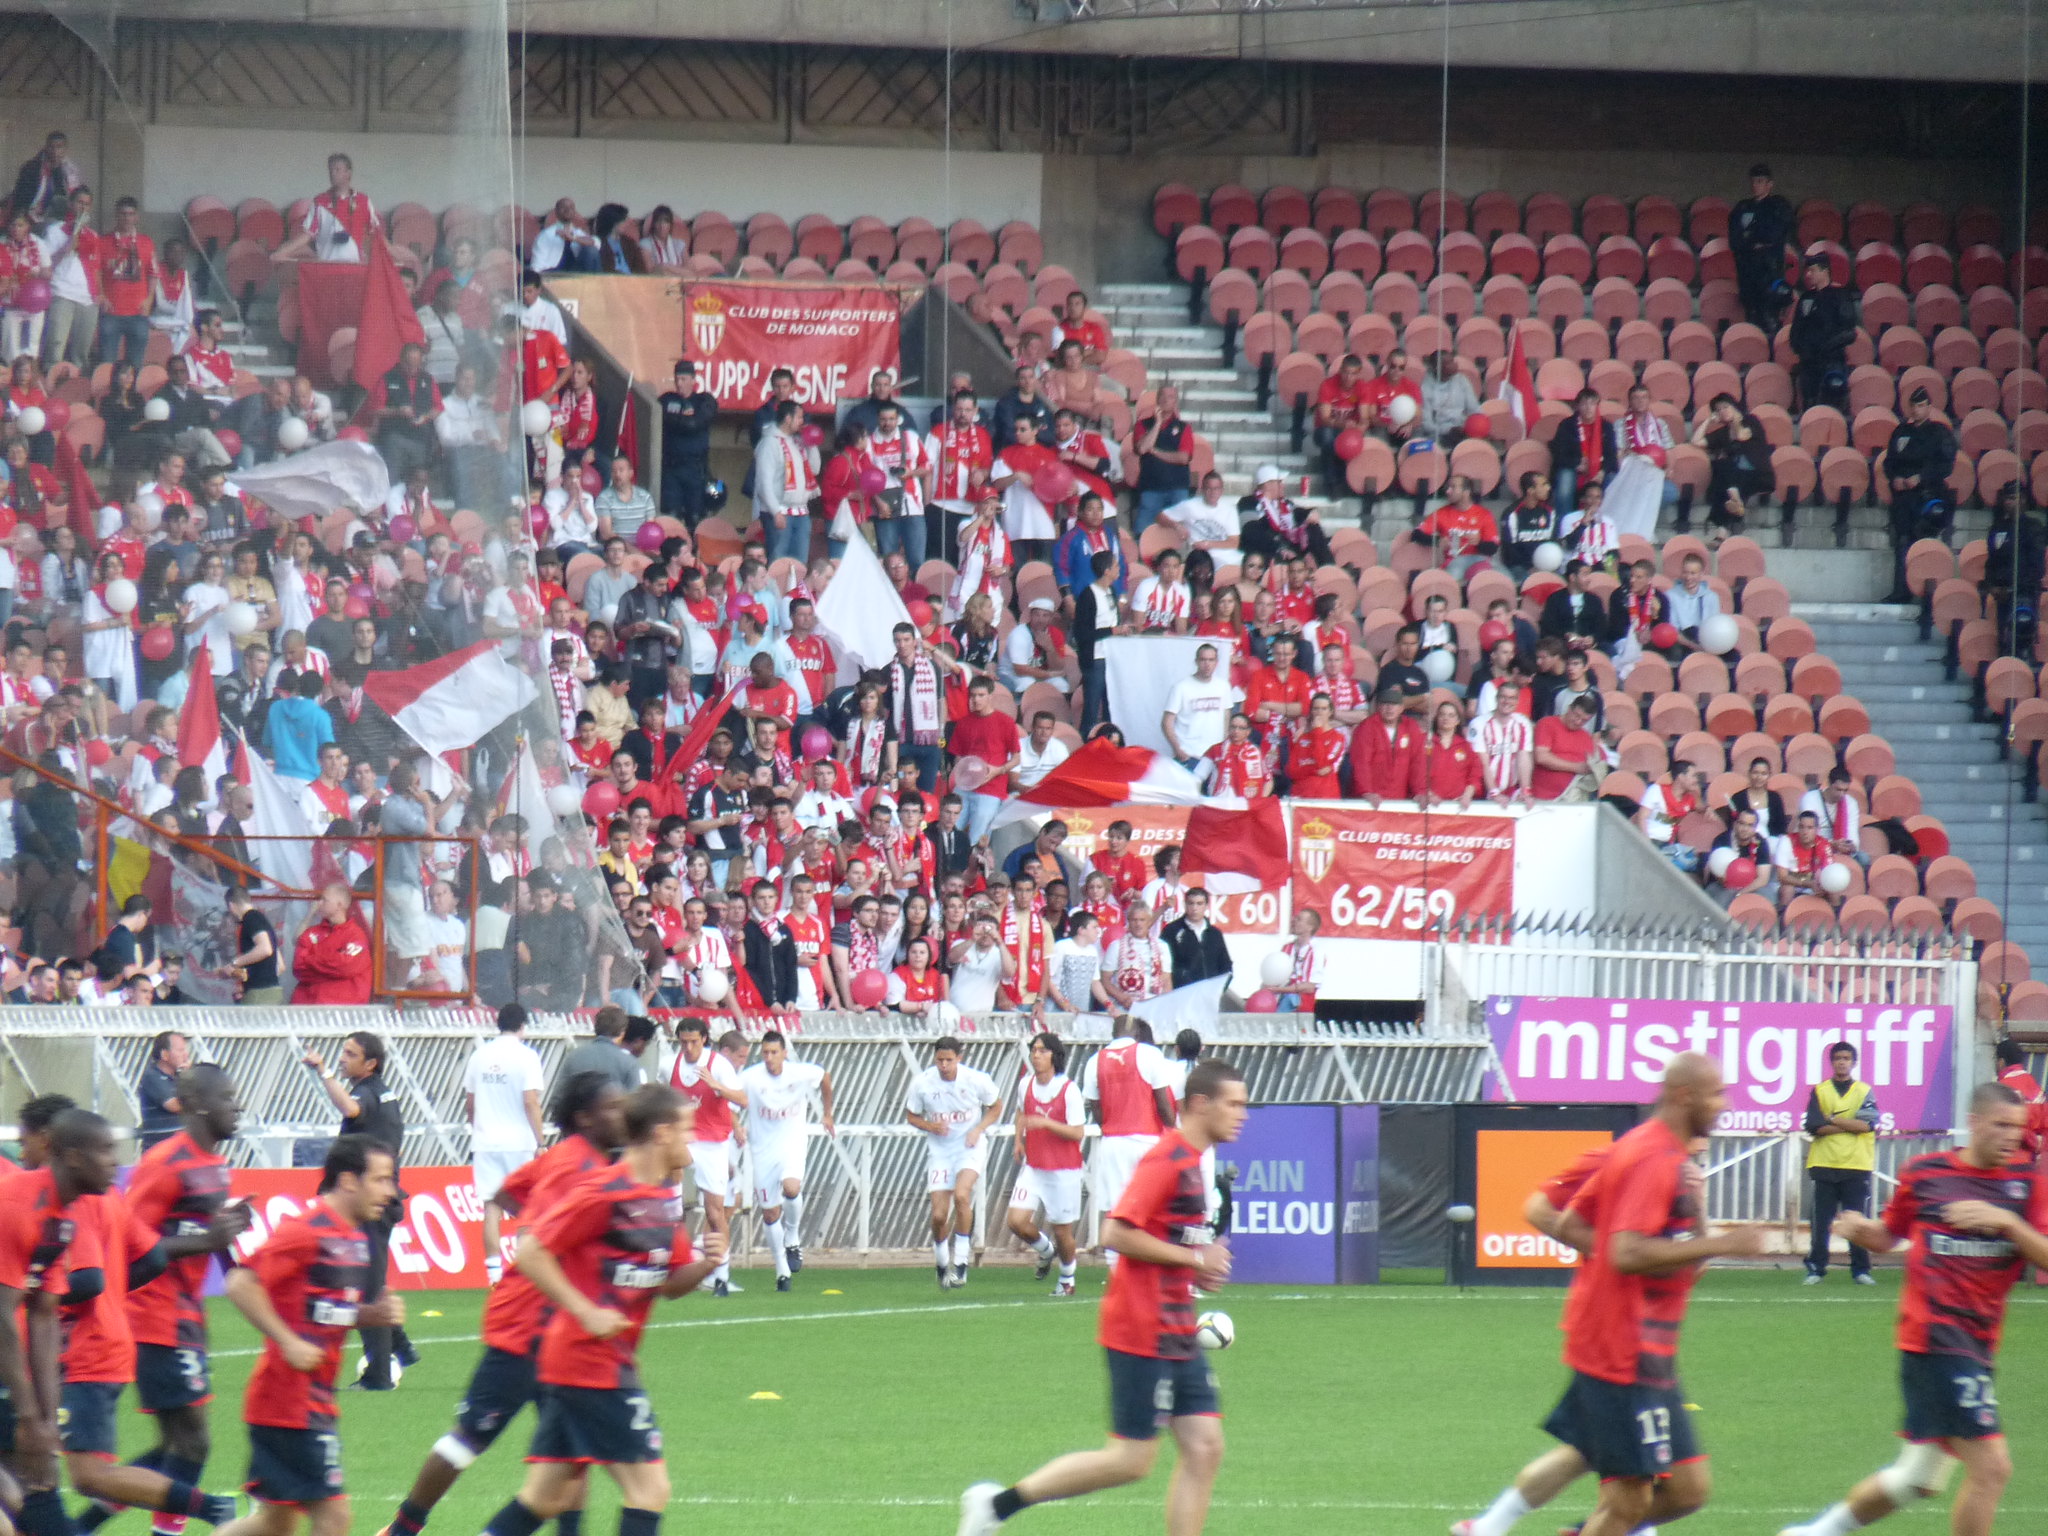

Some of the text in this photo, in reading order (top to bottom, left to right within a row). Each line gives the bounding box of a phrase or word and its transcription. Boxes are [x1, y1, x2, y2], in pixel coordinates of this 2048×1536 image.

[728, 305, 896, 323] CLUB DES SUPPORTERS
[766, 323, 860, 337] DE MONACO
[1143, 829, 1174, 840] DES
[1338, 830, 1512, 850] CLUB DES SUPPORTERS
[1376, 848, 1474, 864] DE MONACO
[1240, 892, 1277, 925] 60
[1331, 884, 1456, 931] 62/59
[1518, 1003, 1935, 1105] mistigriff
[1718, 1110, 1793, 1130] onnes
[932, 1169, 949, 1185] 21
[1231, 1200, 1335, 1236] LELOU
[1483, 1233, 1579, 1264] orang
